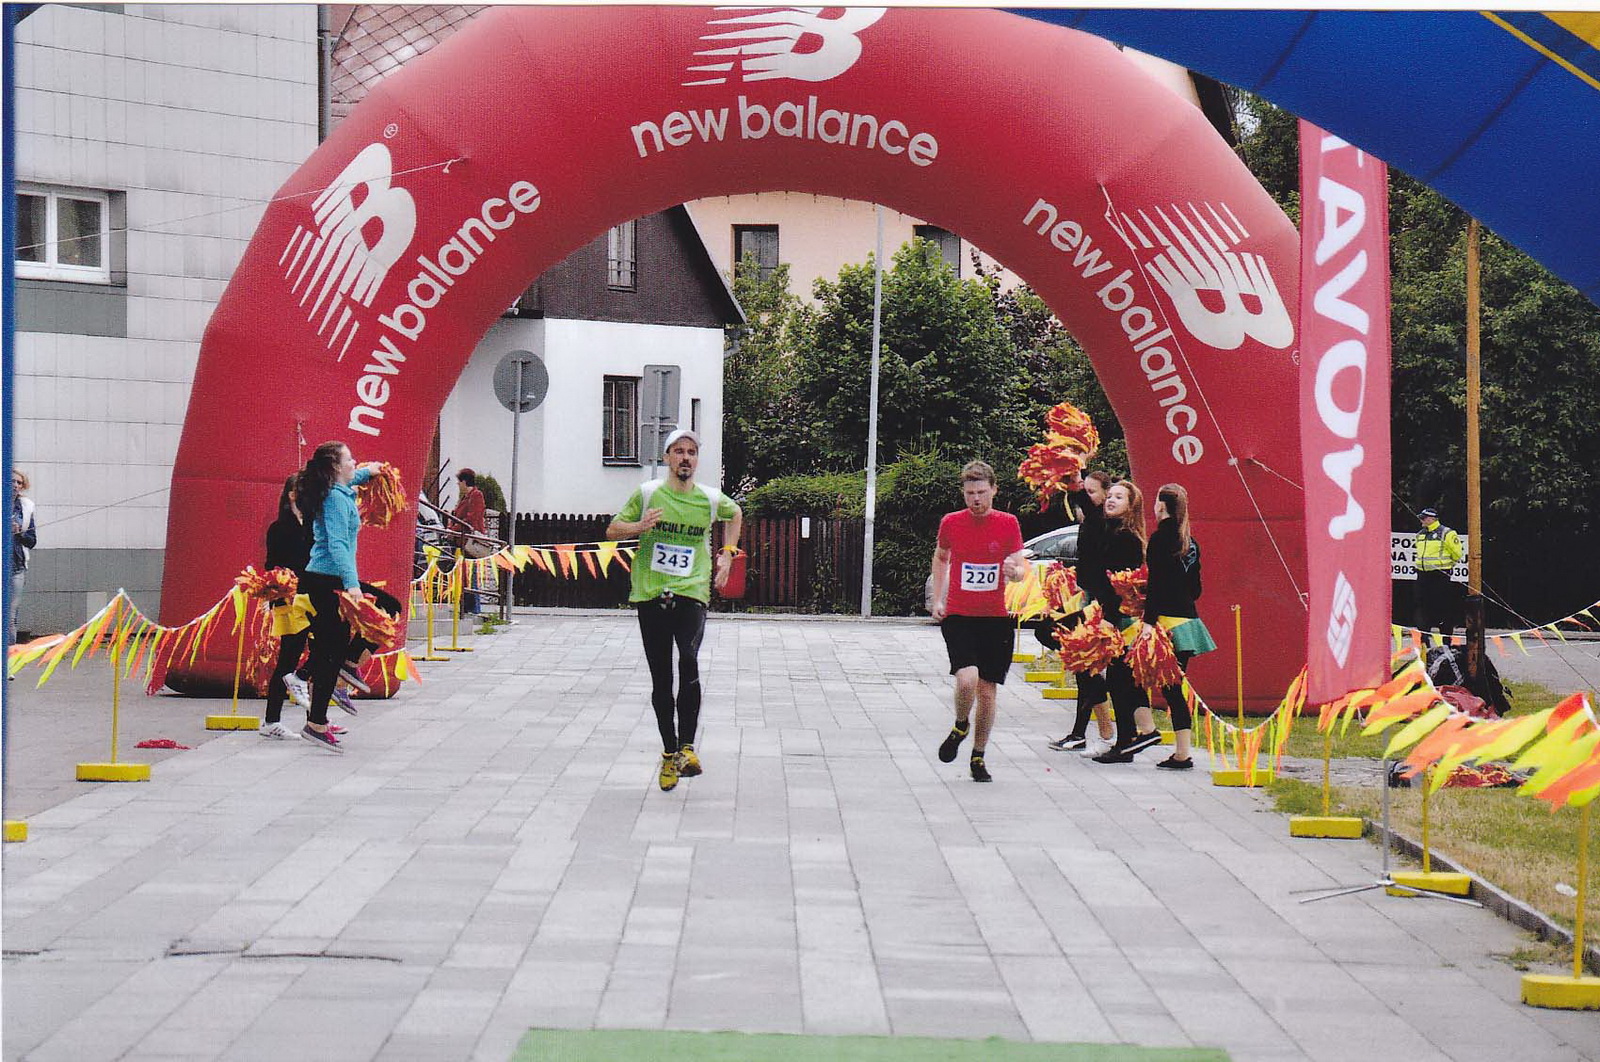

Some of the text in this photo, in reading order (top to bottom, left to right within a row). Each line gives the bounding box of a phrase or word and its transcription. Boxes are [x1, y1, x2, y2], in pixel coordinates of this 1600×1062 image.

[630, 95, 939, 167] new balance
[348, 180, 541, 436] new balance
[1022, 198, 1204, 465] new balance
[656, 551, 689, 569] 243
[965, 571, 996, 584] 220
